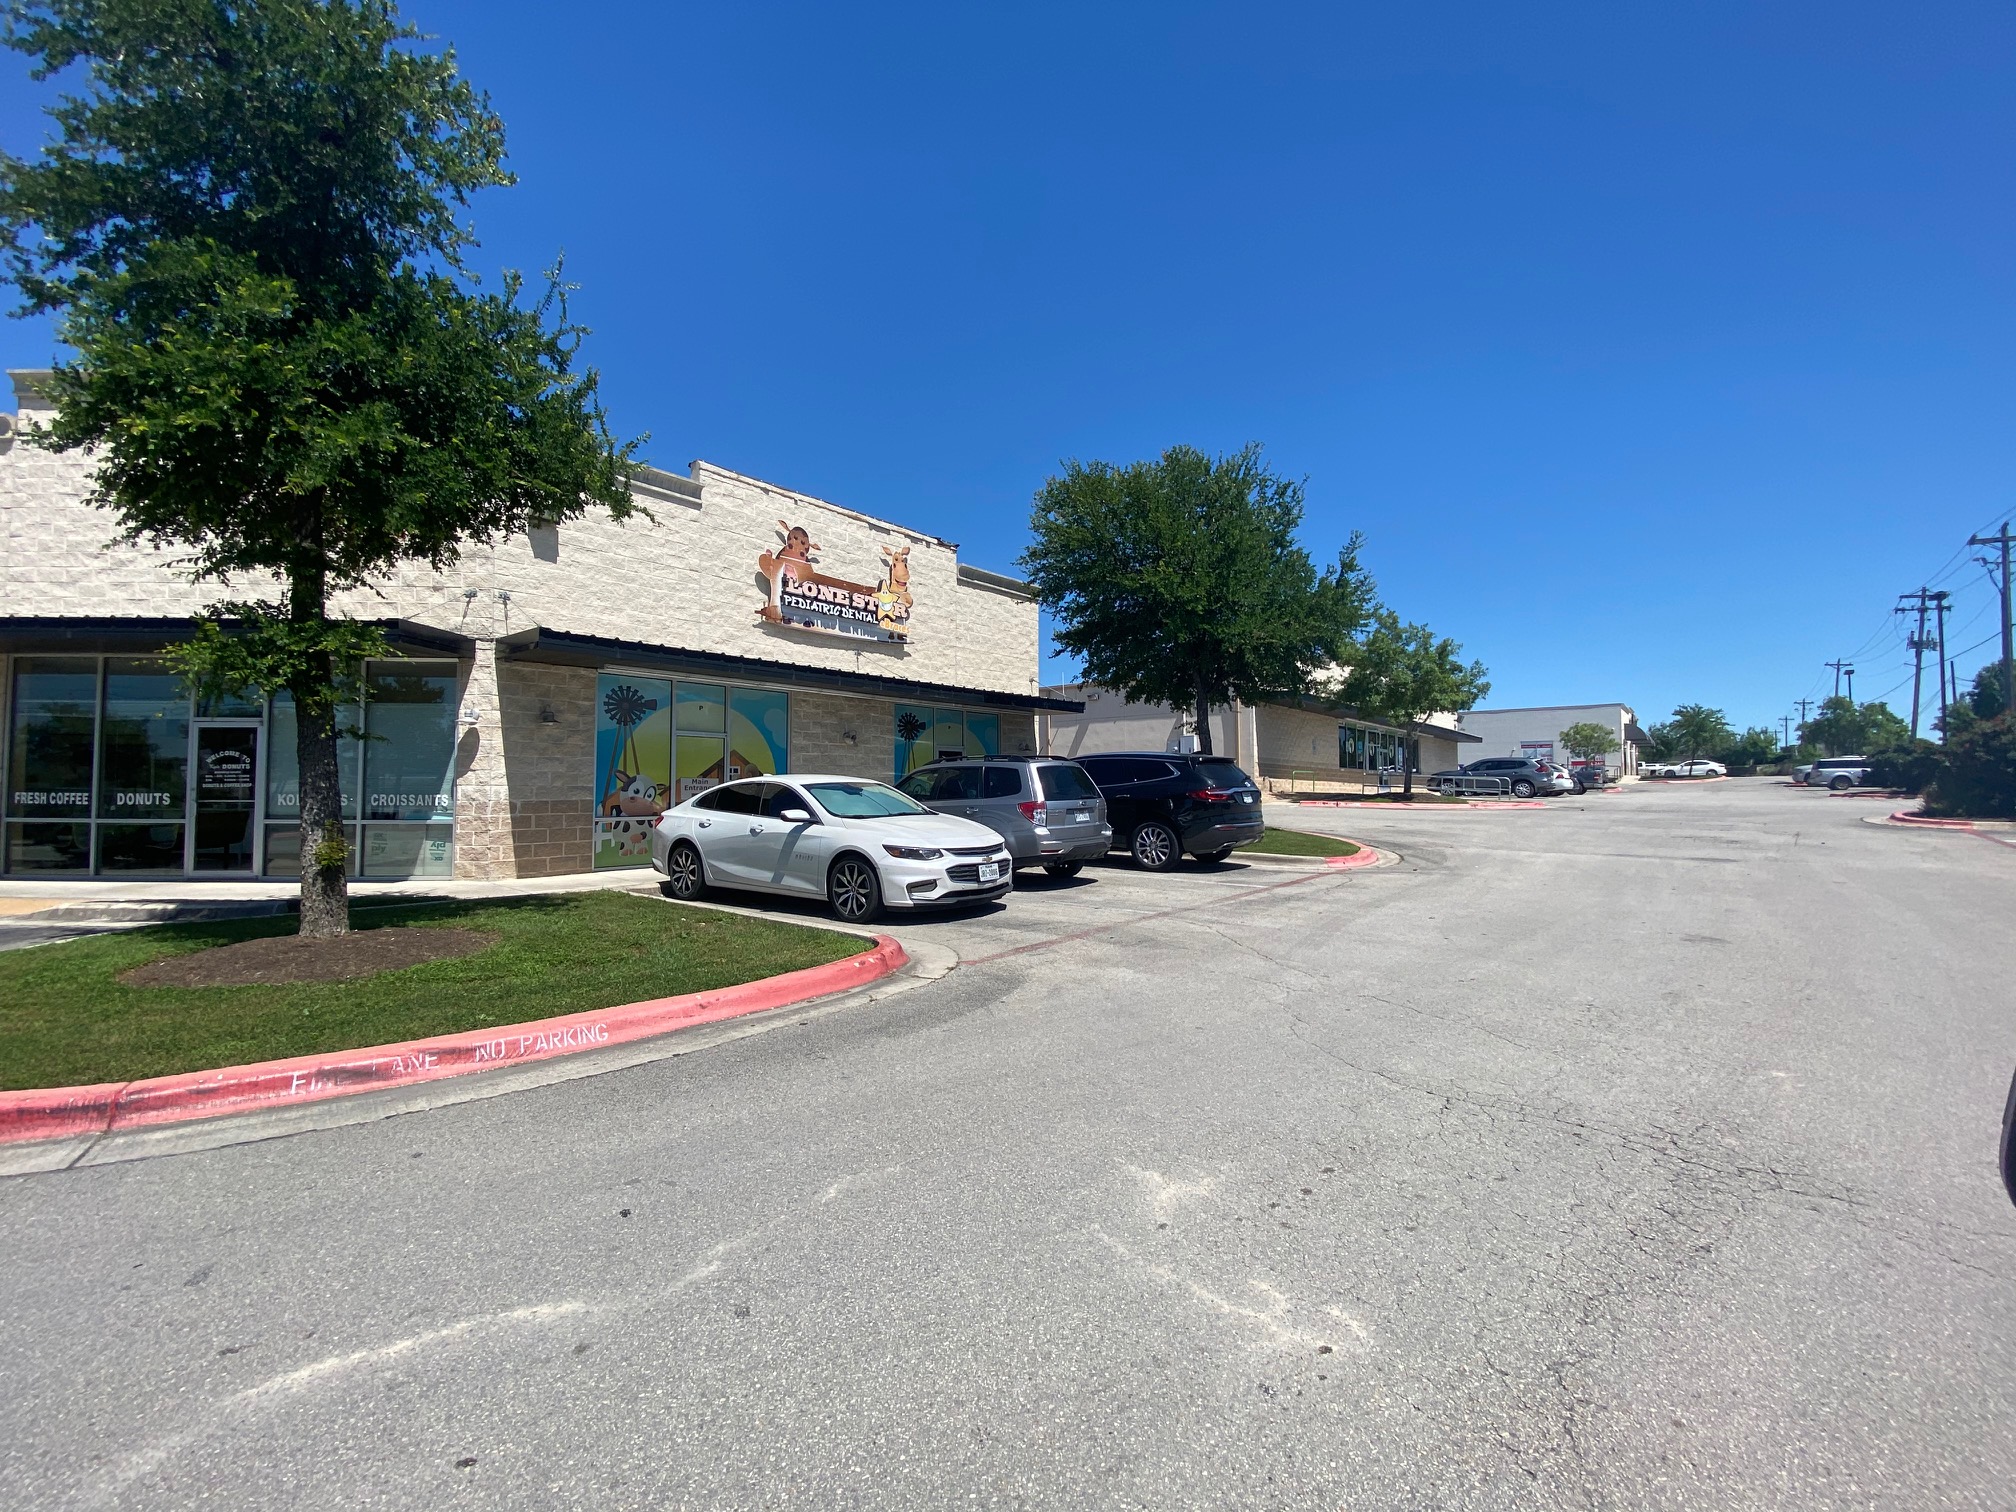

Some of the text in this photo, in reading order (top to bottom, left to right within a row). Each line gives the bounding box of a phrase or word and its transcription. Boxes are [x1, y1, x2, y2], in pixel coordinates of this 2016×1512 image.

[786, 576, 907, 618] LONE STR
[784, 595, 879, 624] PEDIATRIC DENTAL
[206, 750, 251, 763] WELCOME TO
[14, 792, 89, 805] FRESH COFFEE
[116, 792, 171, 805] DONUTS
[370, 793, 449, 807] CROISSANTS
[474, 1039, 506, 1063] NO
[519, 1023, 610, 1055] PARKING
